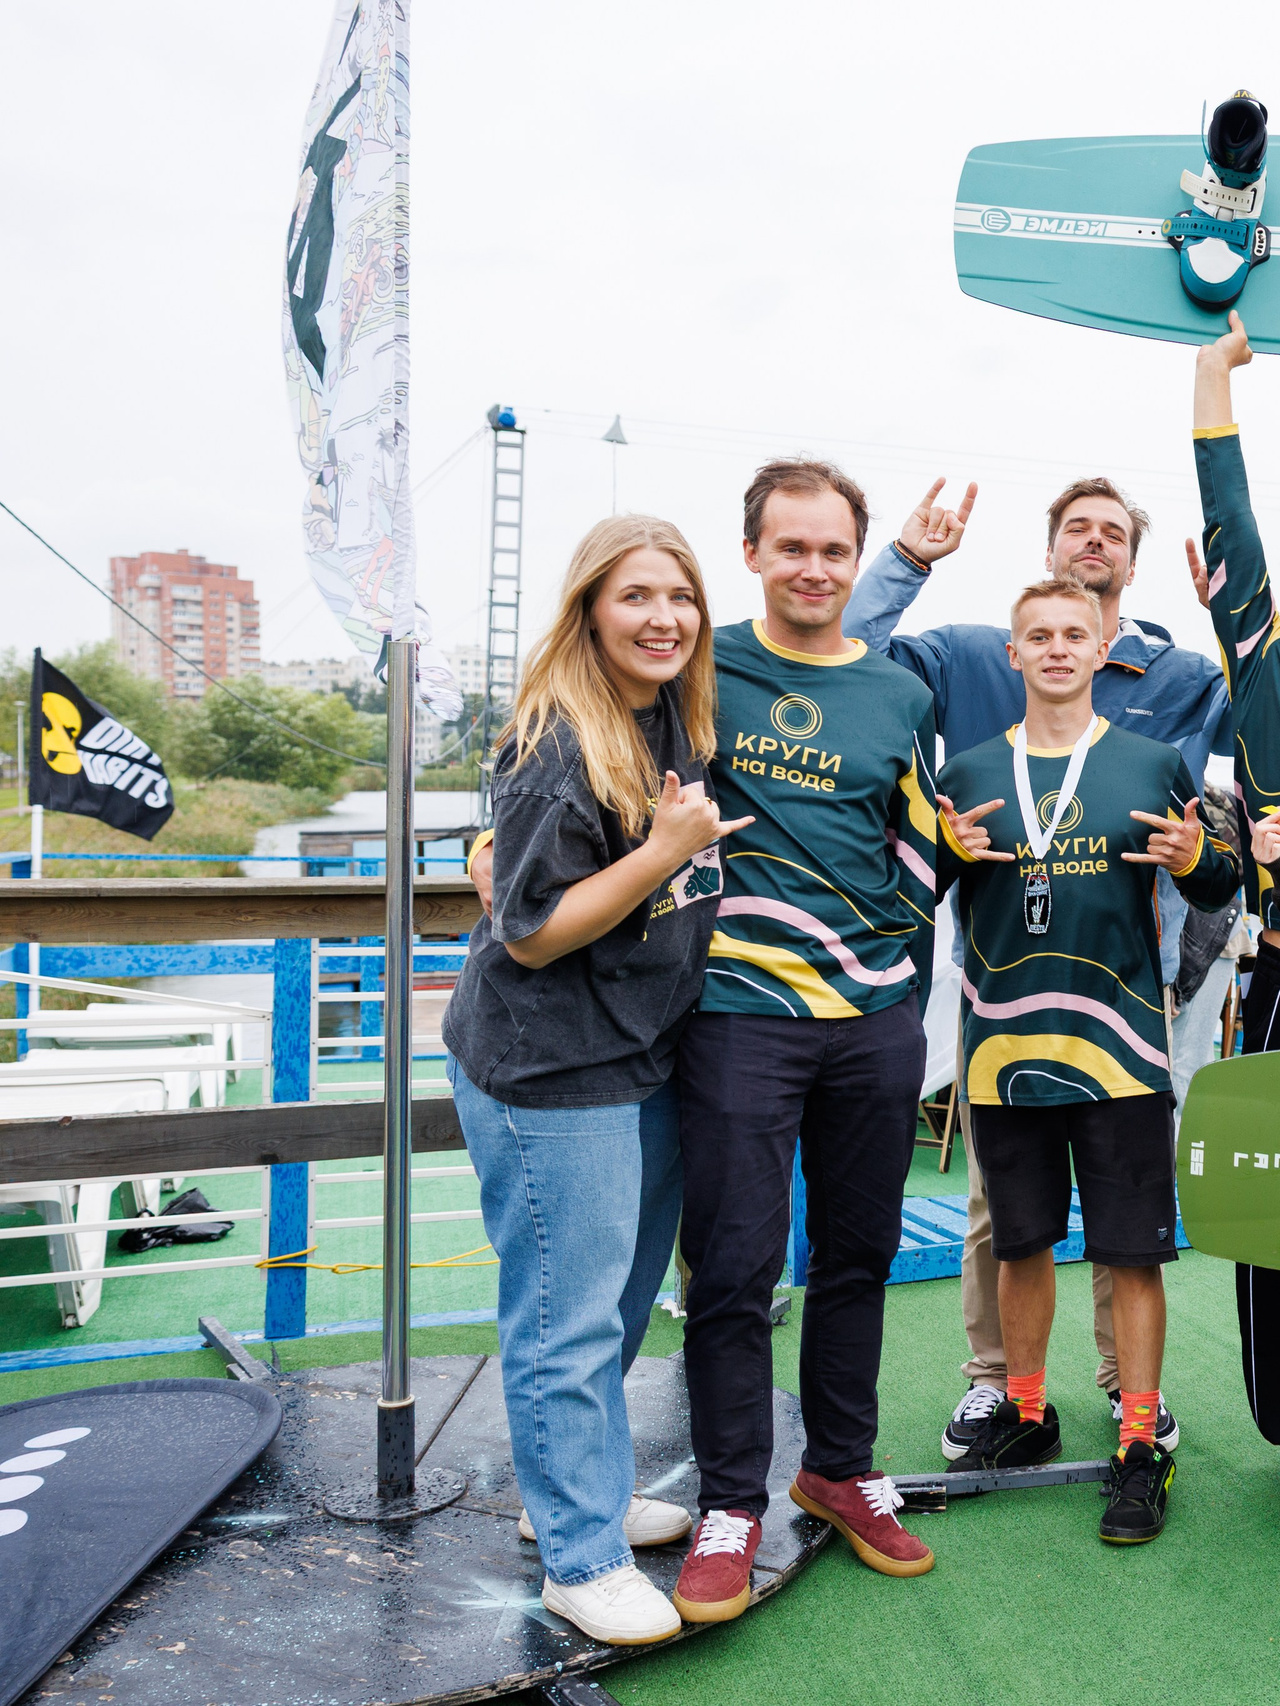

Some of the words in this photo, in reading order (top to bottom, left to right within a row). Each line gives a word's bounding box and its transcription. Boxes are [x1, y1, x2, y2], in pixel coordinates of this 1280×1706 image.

[1025, 216, 1107, 237] ЭМДЭЙ
[735, 732, 842, 774] КРУГИ
[732, 756, 766, 776] на
[771, 765, 836, 793] воде
[1016, 836, 1107, 859] КУГИ
[1052, 859, 1108, 876] воде
[652, 897, 674, 912] РУГИ
